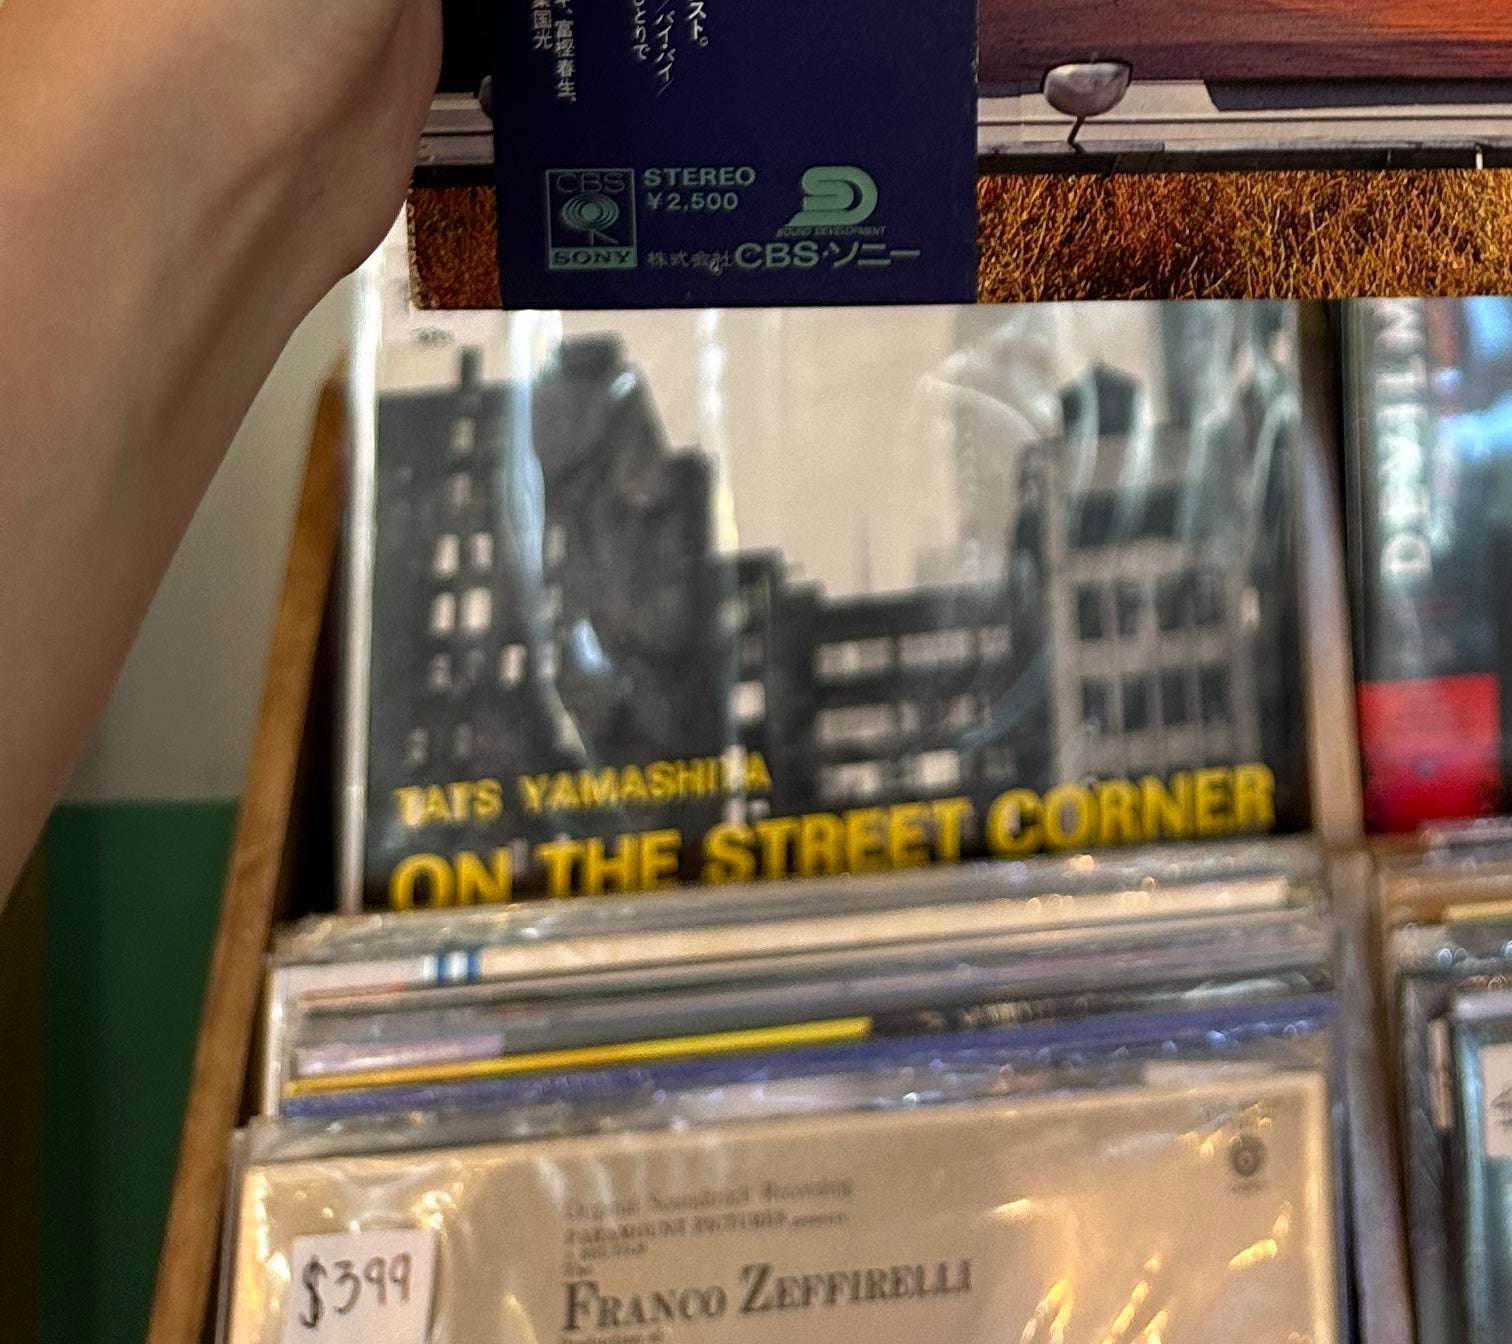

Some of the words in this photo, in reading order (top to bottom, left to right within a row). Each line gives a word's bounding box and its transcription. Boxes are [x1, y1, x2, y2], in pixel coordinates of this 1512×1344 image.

[556, 172, 627, 194] CBS
[644, 167, 757, 187] STEREO
[646, 192, 739, 212] ¥2,500
[553, 249, 633, 266] SONY
[391, 850, 512, 911] ON
[537, 827, 682, 899] THE
[703, 796, 974, 884] STREET
[986, 762, 1277, 859] CORNER
[299, 1253, 414, 1329] $399
